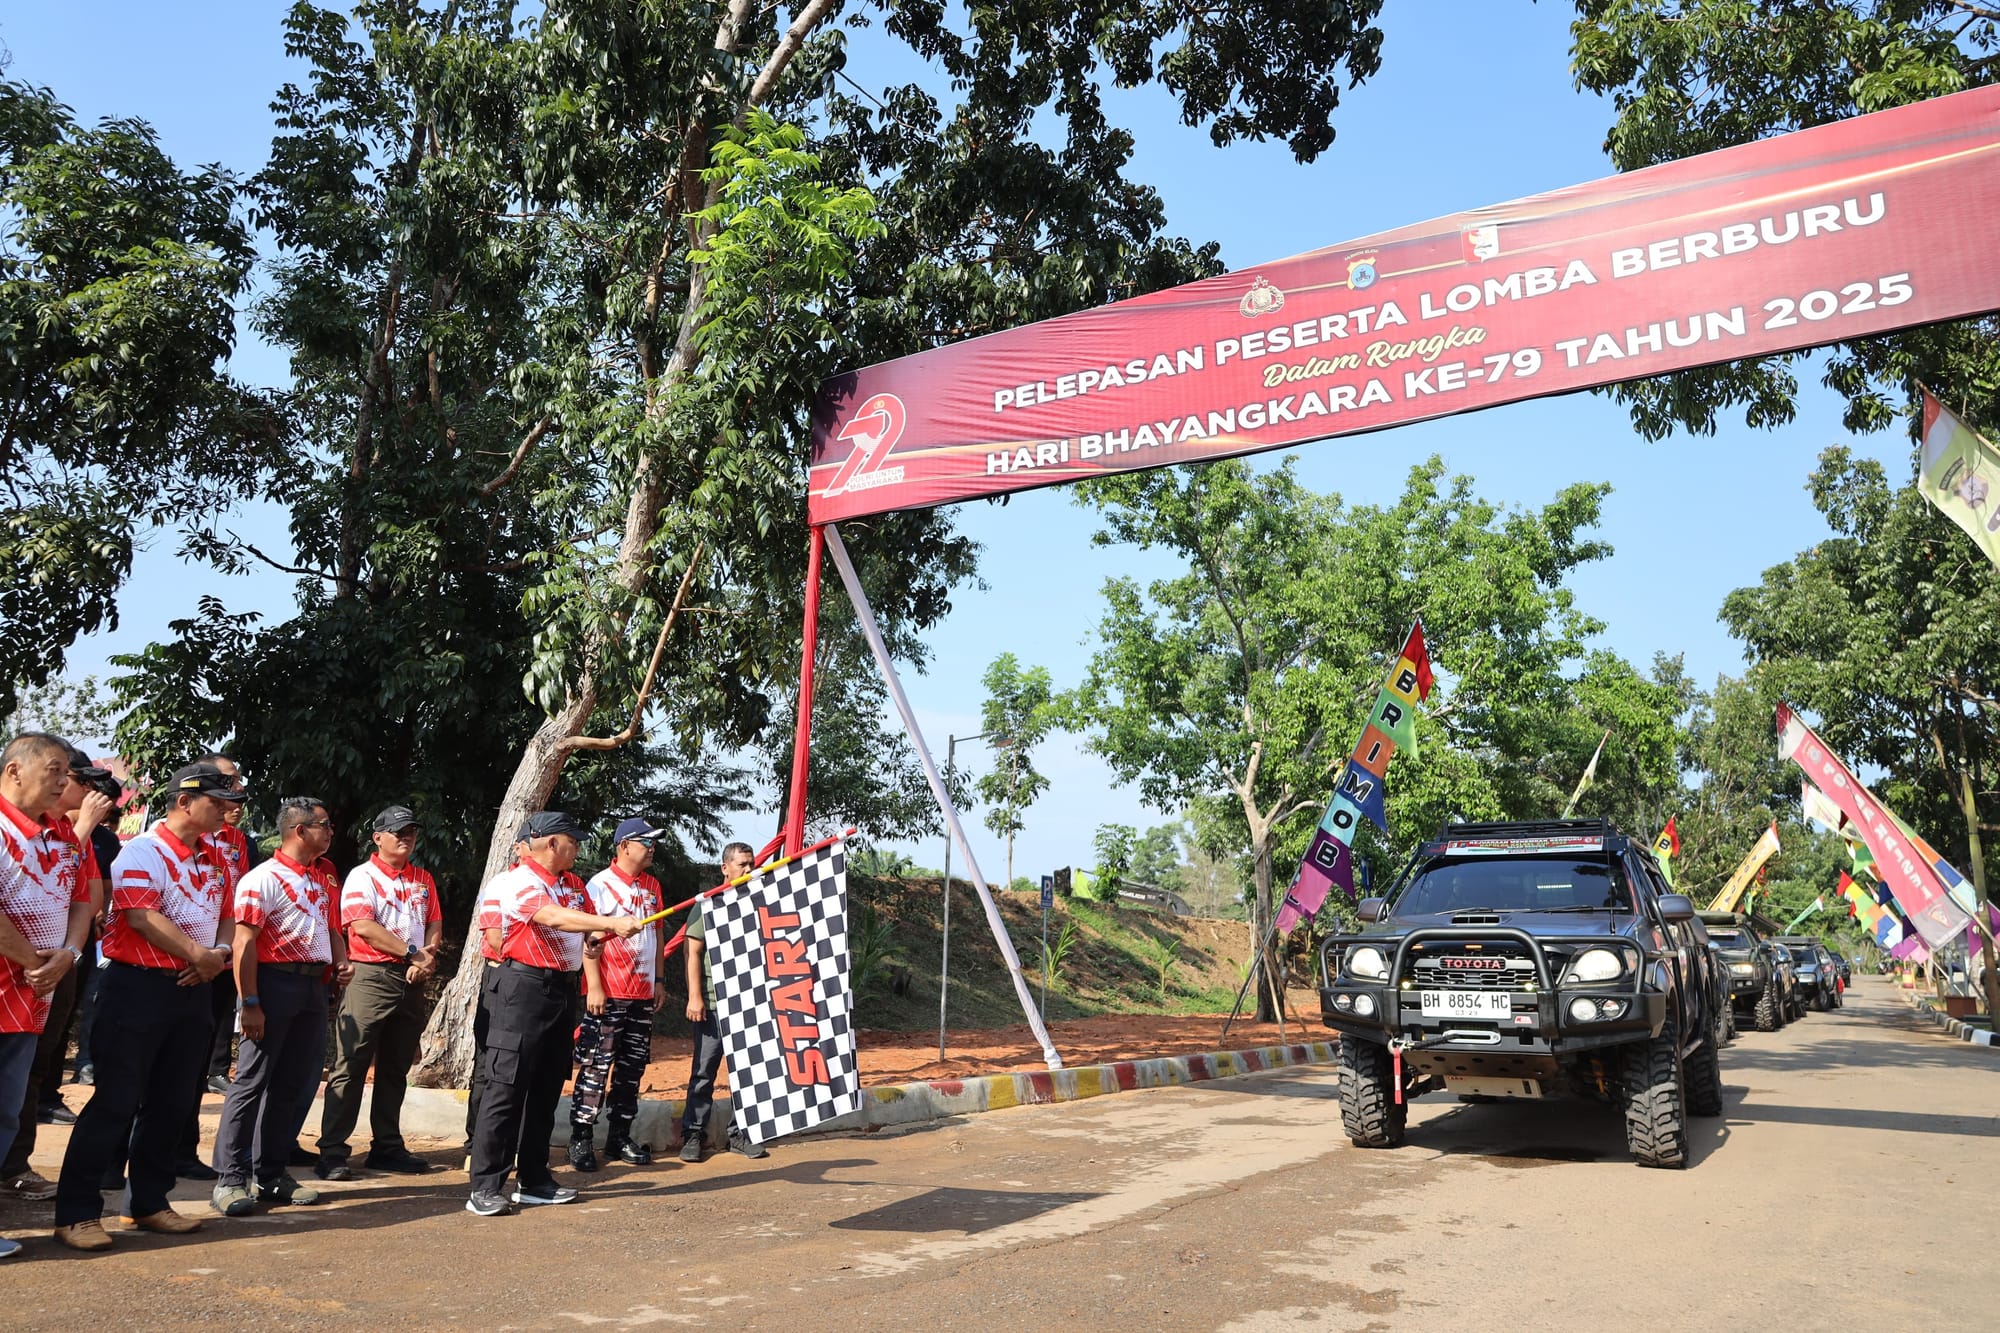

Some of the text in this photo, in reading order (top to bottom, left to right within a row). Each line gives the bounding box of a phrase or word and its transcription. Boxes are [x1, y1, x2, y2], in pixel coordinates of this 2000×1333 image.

[986, 272, 1913, 475] HARI BHAYANGKARA KE-79 TAHUN 2025
[993, 192, 1886, 412] PELEPASAN PESERTA LOMBA BERBURU
[1263, 325, 1486, 388] Dalam Rangka
[1315, 668, 1418, 868] BRIMOB
[757, 905, 831, 1086] START
[1423, 993, 1508, 1009] BH 8854 HC
[1445, 959, 1501, 969] TOYOTA
